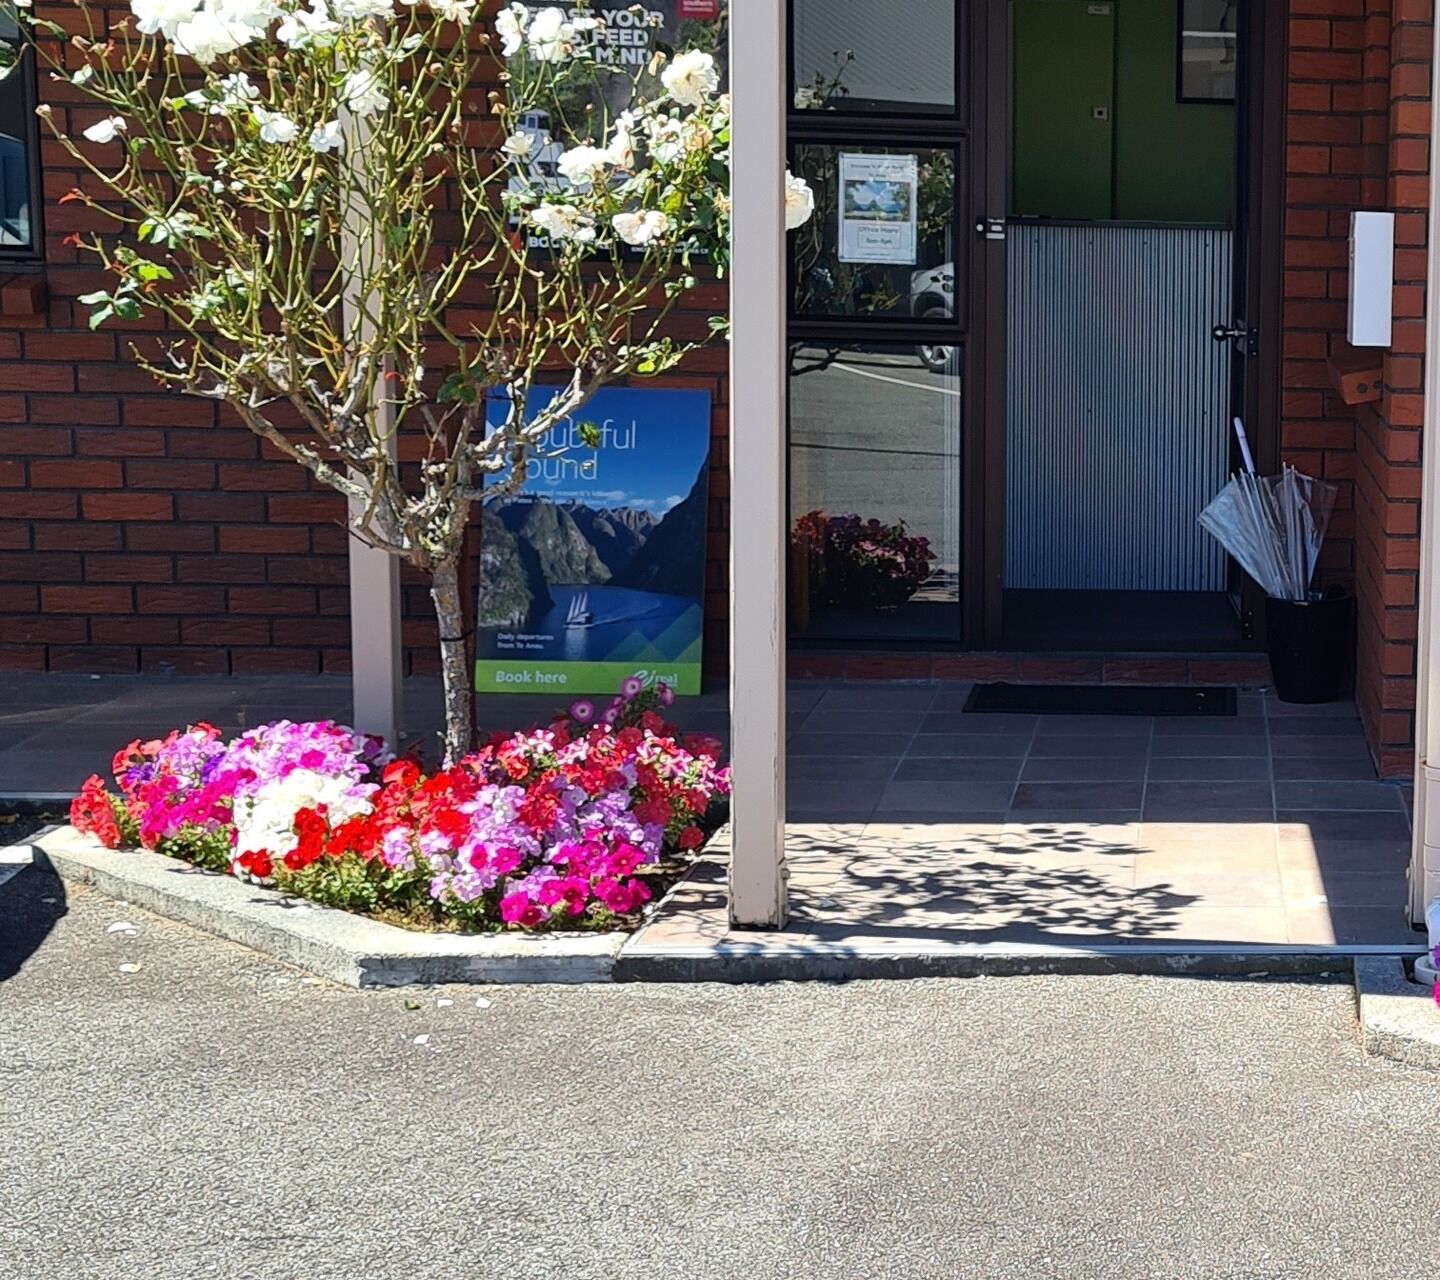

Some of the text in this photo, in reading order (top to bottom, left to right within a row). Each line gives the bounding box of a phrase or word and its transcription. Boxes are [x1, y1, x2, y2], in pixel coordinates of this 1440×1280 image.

[527, 6, 665, 29] FST YOUR
[592, 28, 649, 46] FEED
[596, 47, 652, 65] MND
[508, 419, 636, 449] oubful
[495, 671, 567, 684] Book here
